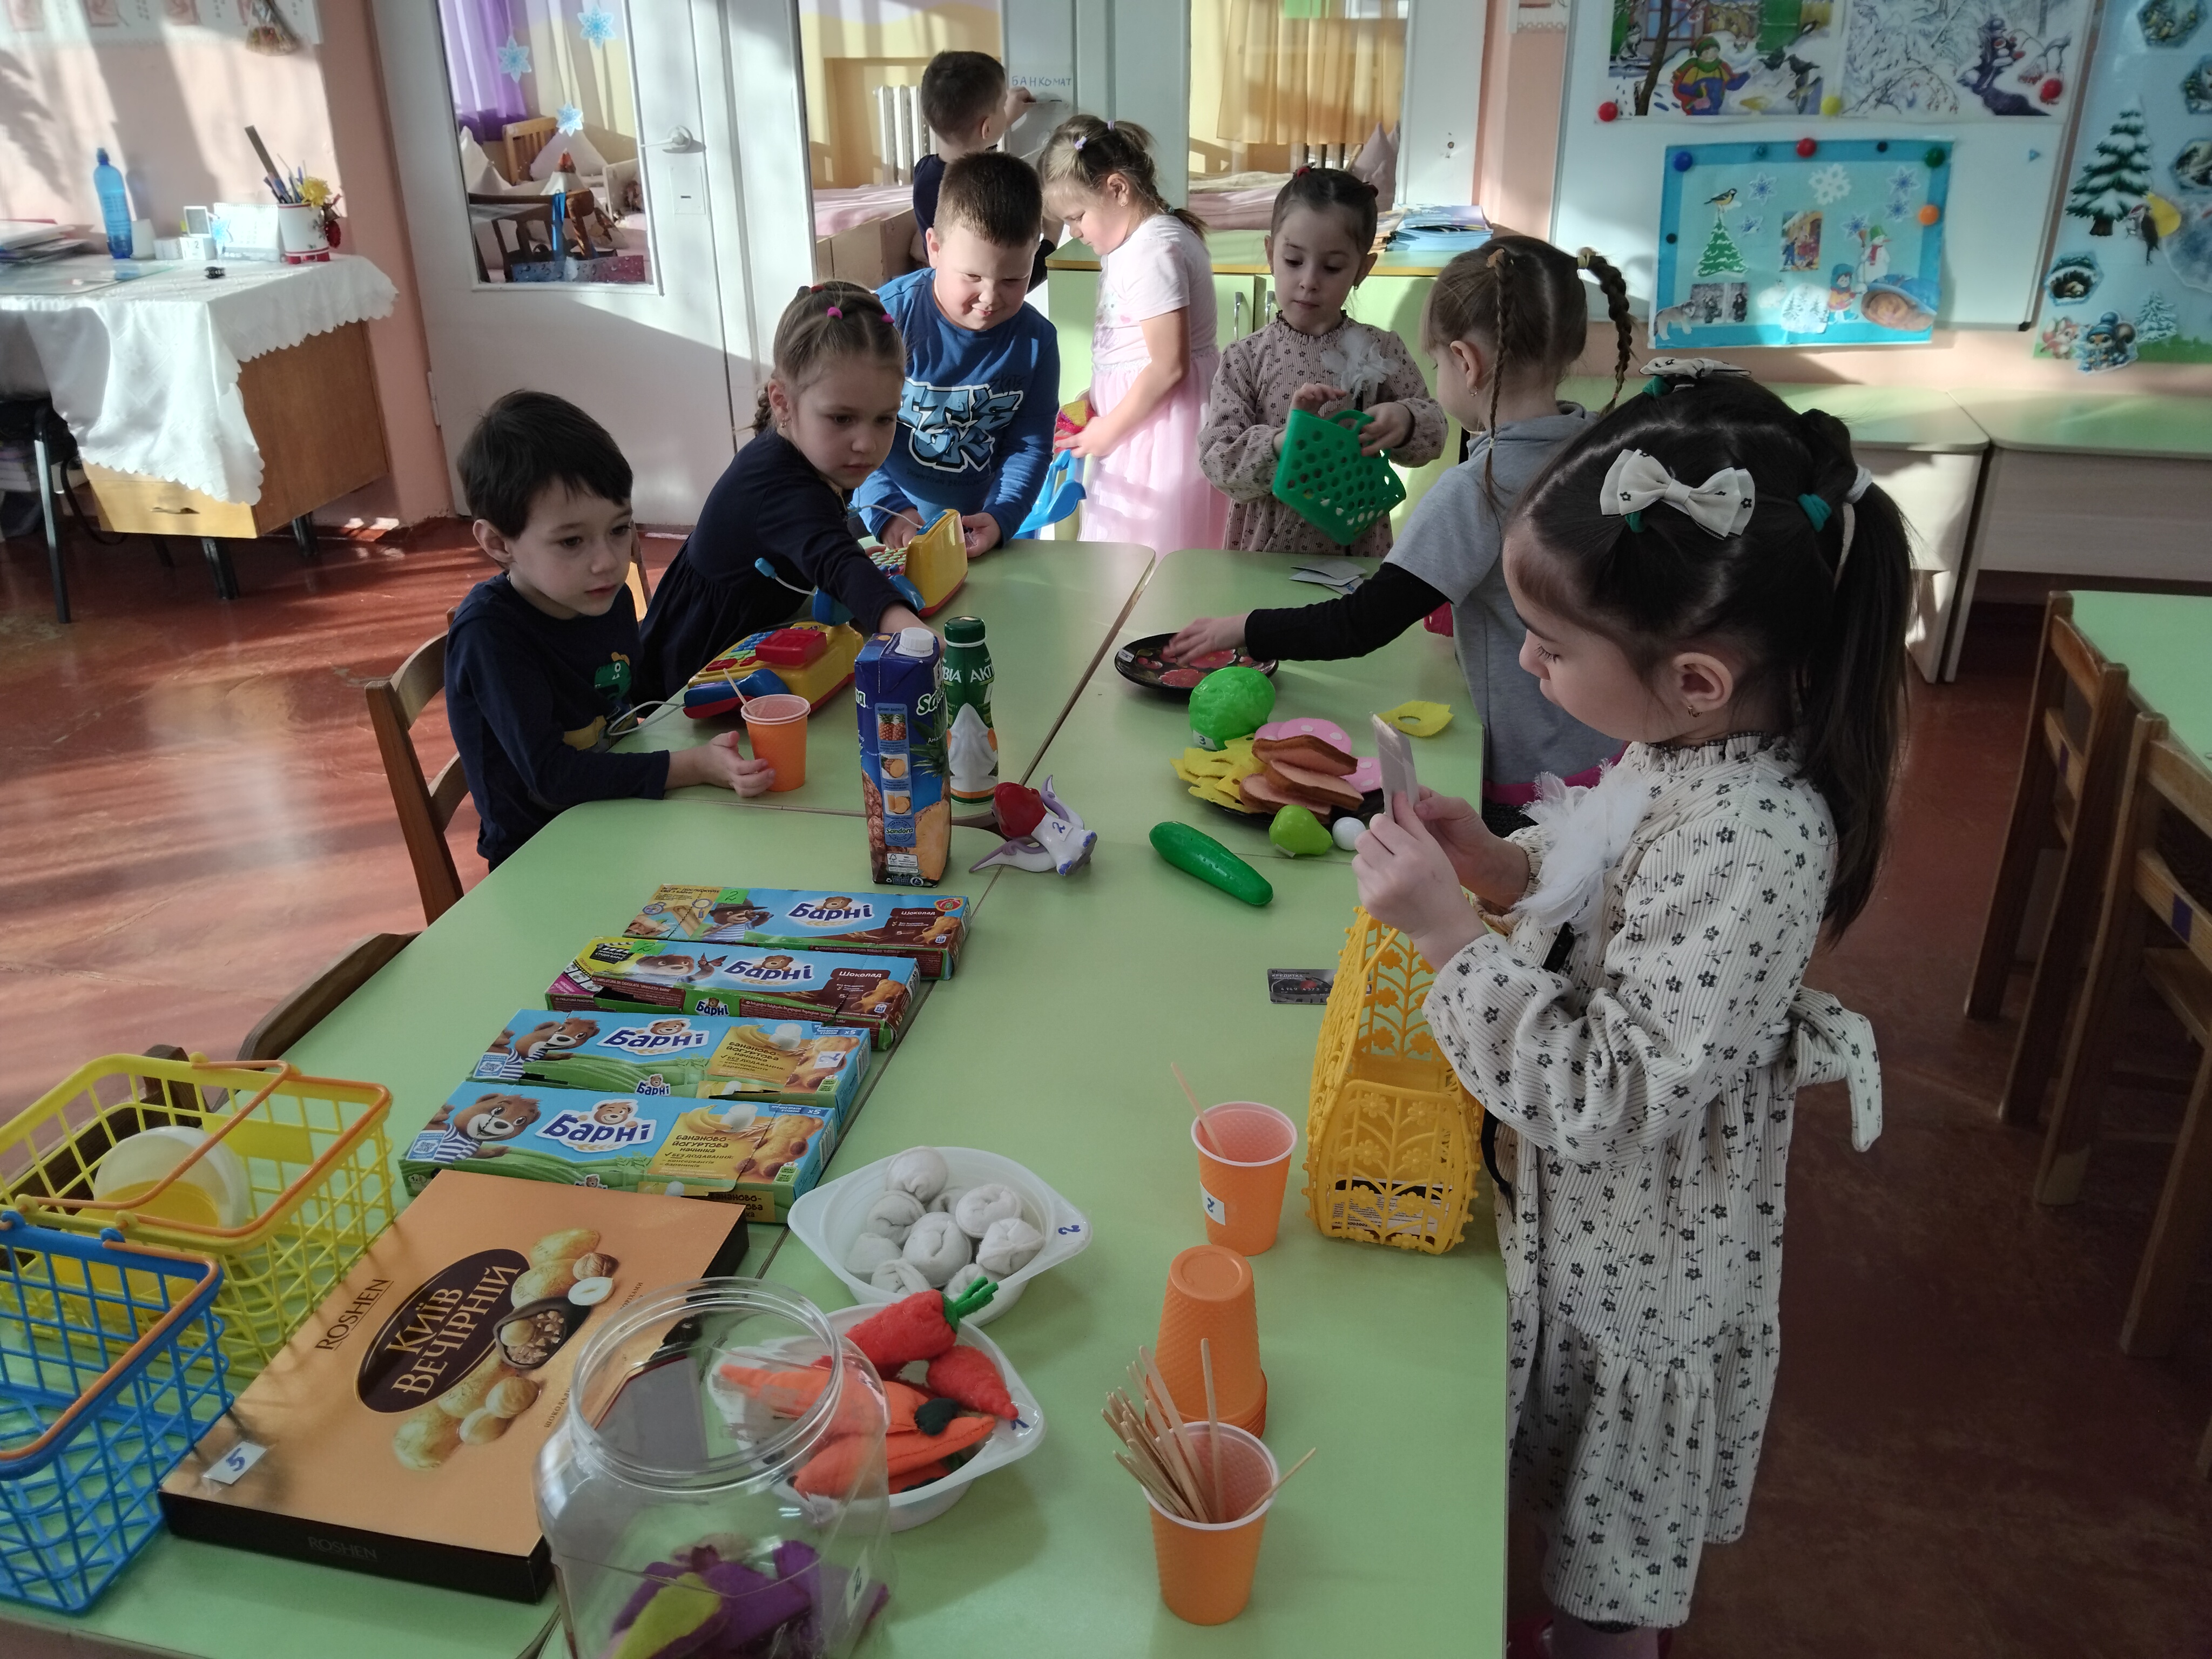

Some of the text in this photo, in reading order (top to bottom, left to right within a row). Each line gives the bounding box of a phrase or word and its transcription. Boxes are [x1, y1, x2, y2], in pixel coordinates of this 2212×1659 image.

[1011, 75, 1071, 87] БАНКОМАТ
[1199, 735, 1206, 745] 3
[725, 891, 738, 901] 2
[788, 902, 872, 921] Барні
[637, 942, 655, 952] 2
[724, 961, 812, 980] Барні
[696, 1001, 728, 1016] Барні
[603, 1028, 706, 1049] Барні
[637, 1082, 670, 1096] Барні
[542, 1114, 651, 1143] Барні
[620, 1282, 643, 1310] ОРІХАМИ
[315, 1278, 391, 1351] ROSHEN
[386, 1283, 463, 1355] КИЇВ
[390, 1264, 520, 1397] ВЕЧІРНІЙ
[226, 1448, 247, 1473] 5
[307, 1536, 377, 1560] ROSHEN
